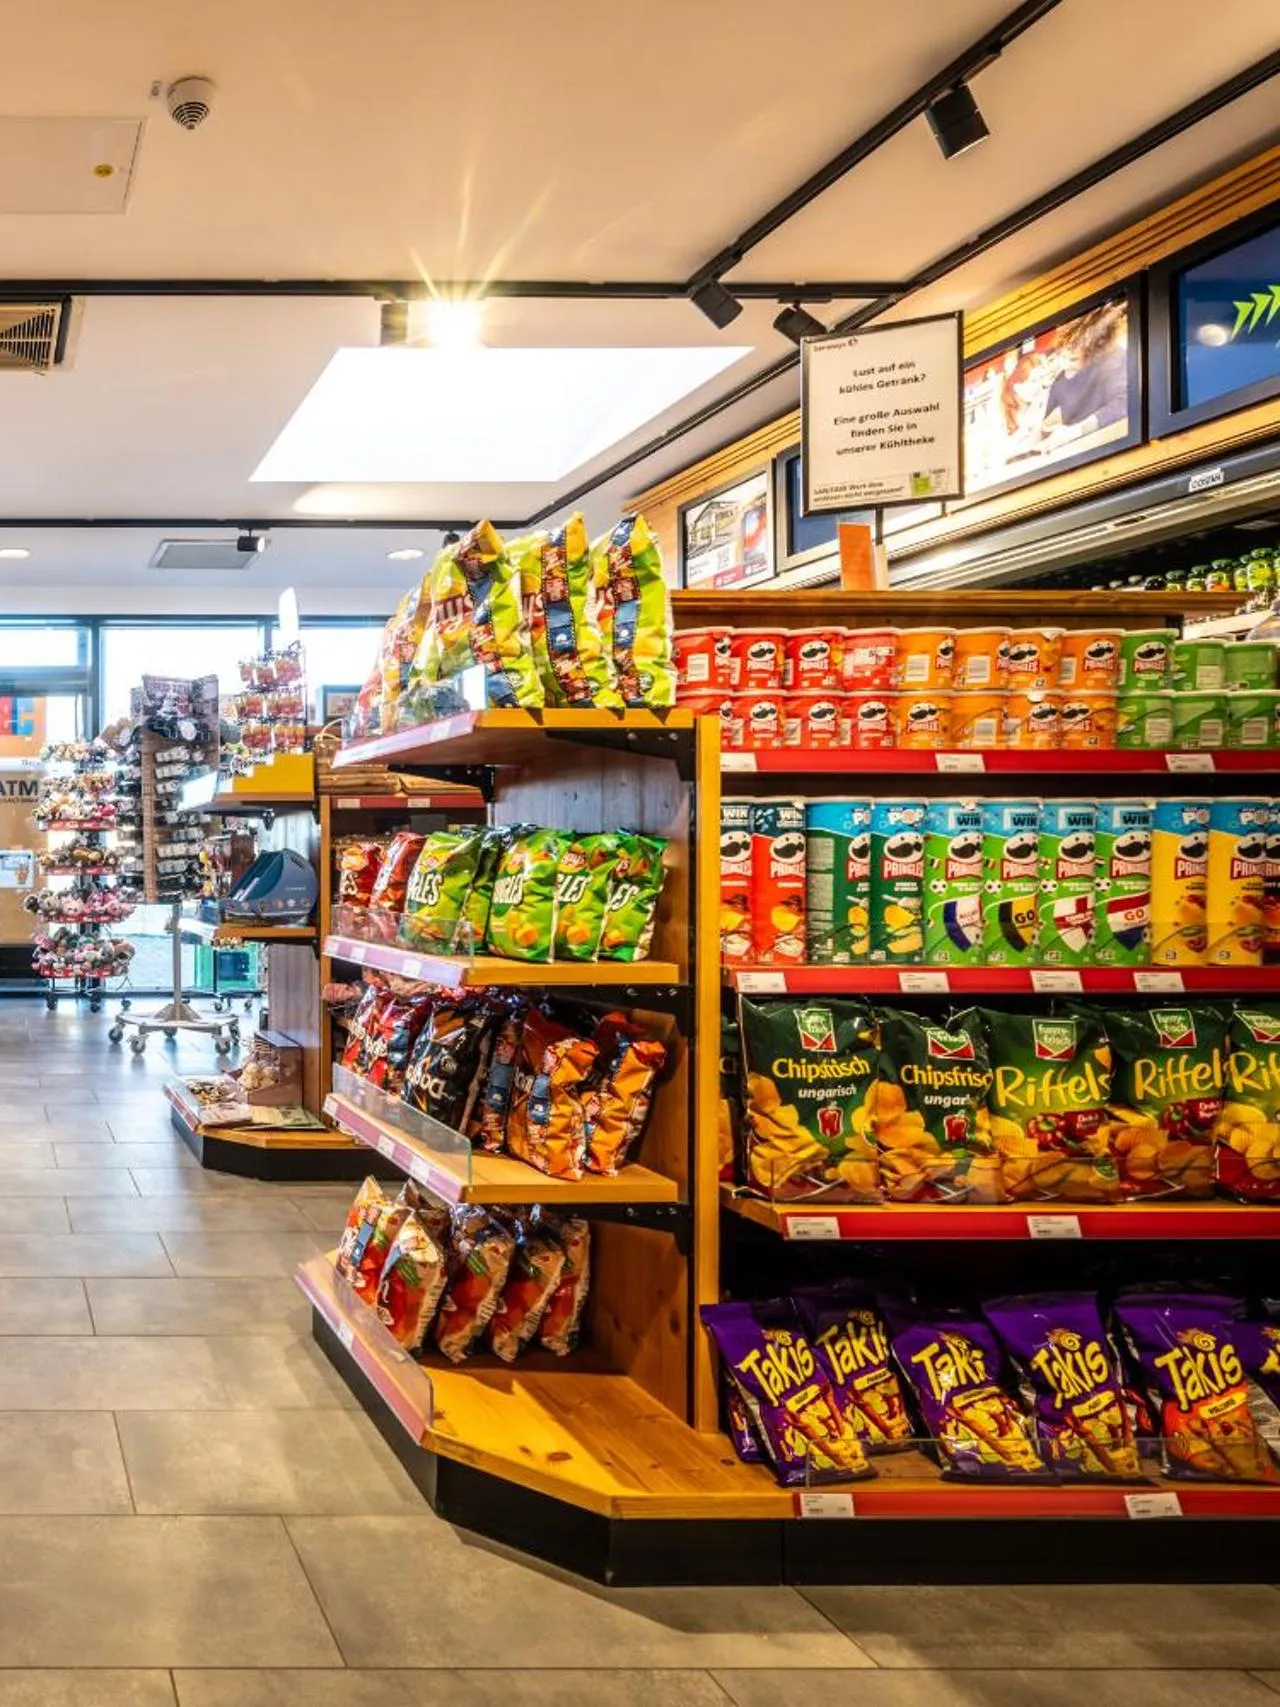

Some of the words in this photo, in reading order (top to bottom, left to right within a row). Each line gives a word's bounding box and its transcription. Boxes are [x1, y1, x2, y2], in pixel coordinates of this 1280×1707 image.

[853, 367, 875, 377] Lust
[878, 362, 895, 374] auf
[898, 361, 916, 370] ein
[839, 381, 874, 395] kühles
[833, 415, 856, 426] Eine
[858, 410, 890, 425] große
[893, 402, 940, 417] Auswahl
[850, 425, 885, 438] finden
[887, 423, 904, 433] Sie
[906, 422, 917, 431] in
[836, 443, 876, 456] unserer
[879, 435, 935, 450] Kühltheke
[1015, 910, 1036, 924] GO
[1123, 909, 1144, 922] GO
[1134, 1048, 1223, 1100] Riffel
[798, 1084, 857, 1101] ungarisch
[737, 1336, 815, 1407] Takis
[1032, 1341, 1109, 1409] Takis
[1154, 1343, 1243, 1411] Takis
